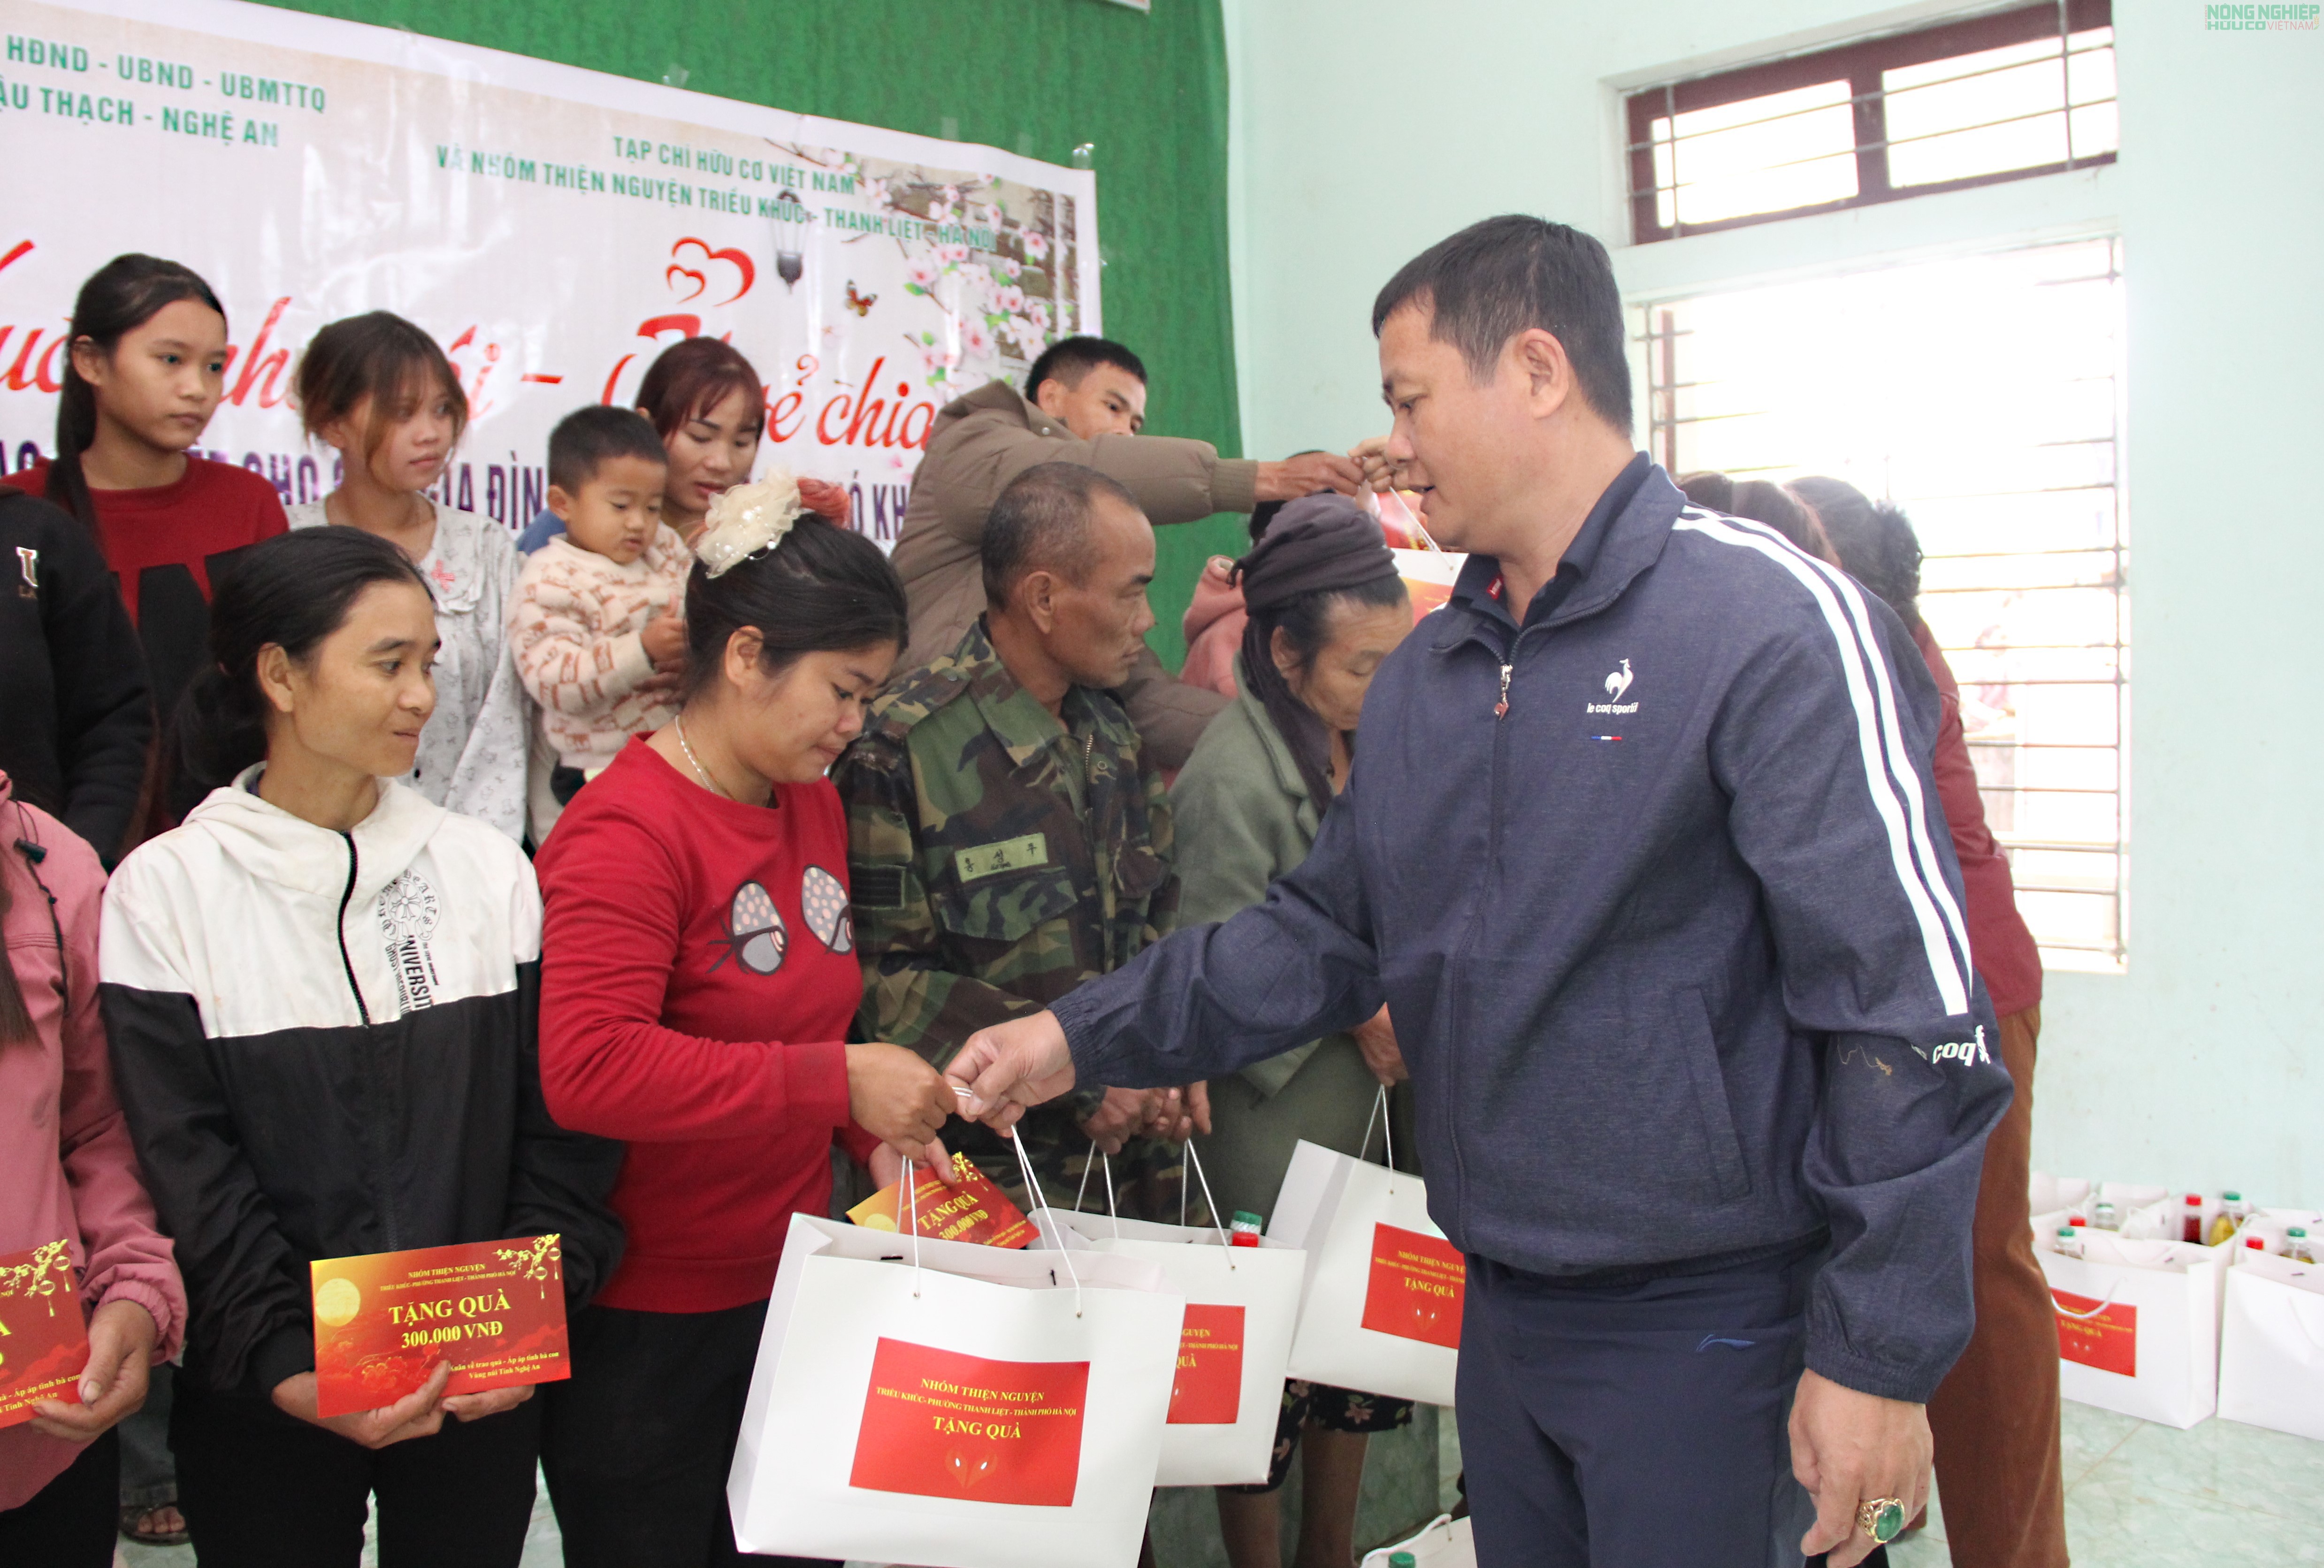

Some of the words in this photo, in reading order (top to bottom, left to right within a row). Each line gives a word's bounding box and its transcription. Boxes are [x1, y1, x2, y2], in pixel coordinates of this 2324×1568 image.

[7, 34, 88, 72] HĐND
[117, 53, 193, 89] UBND
[221, 71, 325, 114] UBMTTQ
[39, 86, 134, 125] THẠCH
[162, 105, 233, 146] NGHỆ
[242, 119, 278, 147] AN
[613, 136, 652, 163] TẠP
[658, 143, 690, 168] CHÍ
[696, 148, 733, 176] HỮU
[739, 159, 764, 182] CƠ
[812, 170, 856, 195] NAM
[471, 151, 536, 183] NHÓM
[543, 162, 605, 195] THIỆN
[612, 172, 692, 207] NGUYỆN
[824, 207, 883, 234] THANH
[816, 356, 935, 450] chia
[1587, 702, 1595, 713] le
[1596, 704, 1612, 714] coq
[1612, 702, 1639, 715] sportif
[917, 1201, 958, 1231] TẶNG
[953, 1190, 979, 1210] QUÀ
[408, 1269, 430, 1279] NHÓM
[432, 1267, 453, 1276] THIỆN
[455, 1263, 486, 1272] NGUYỆN
[1404, 1276, 1432, 1292] TẶNG
[1434, 1285, 1455, 1298] QUÀ
[389, 1299, 453, 1327] TẶNG
[458, 1288, 512, 1318] QUÀ
[401, 1325, 461, 1348] 300.000
[463, 1321, 503, 1338] VNĐ
[1182, 1328, 1211, 1338] GUYỆN
[920, 1378, 959, 1394] NHÓM
[961, 1386, 998, 1401] THIỆN
[1000, 1391, 1045, 1403] NGUYỆN
[963, 1404, 991, 1414] THANH
[1052, 1406, 1063, 1415] HÀ
[933, 1416, 983, 1436] TẶNG
[986, 1422, 1022, 1440] QUÀ
